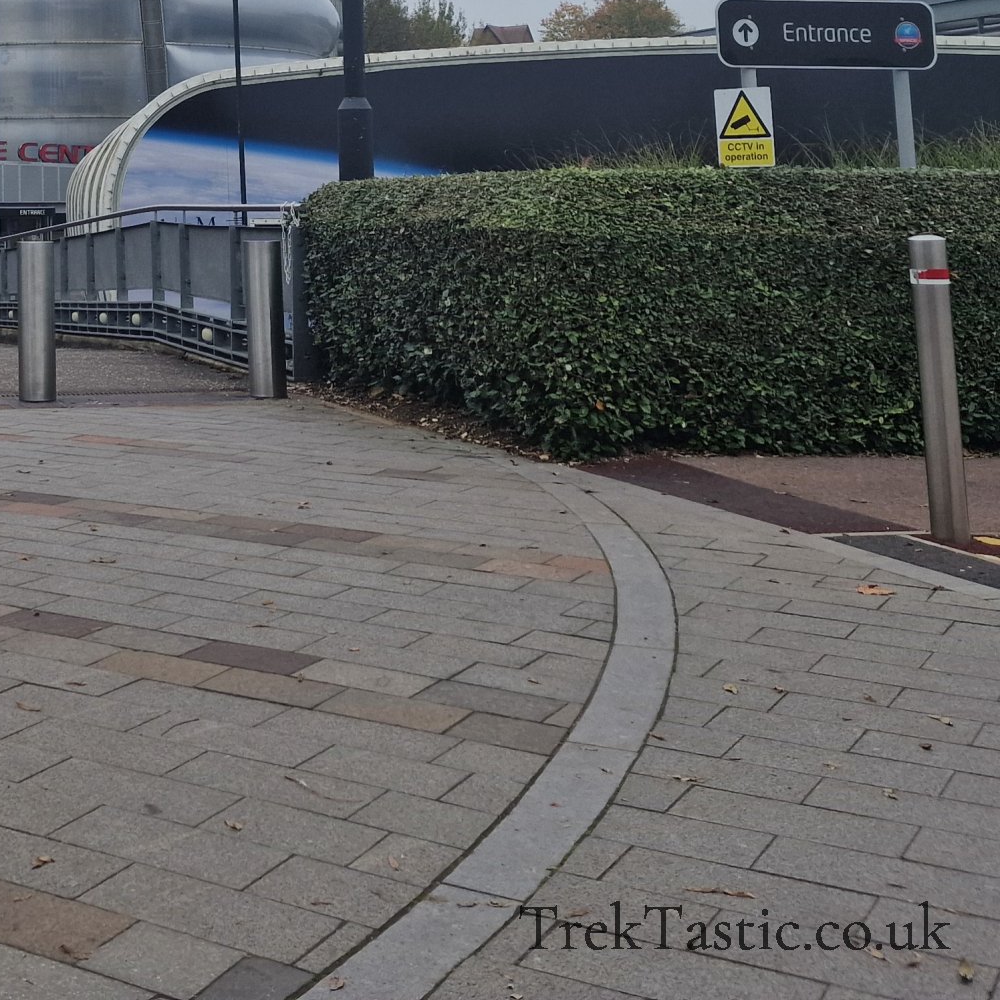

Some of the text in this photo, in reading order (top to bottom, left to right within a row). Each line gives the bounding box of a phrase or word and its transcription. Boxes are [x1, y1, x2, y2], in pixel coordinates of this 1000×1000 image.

[783, 22, 871, 42] Entrance
[728, 142, 764, 151] CCTV in
[725, 152, 768, 163] operation
